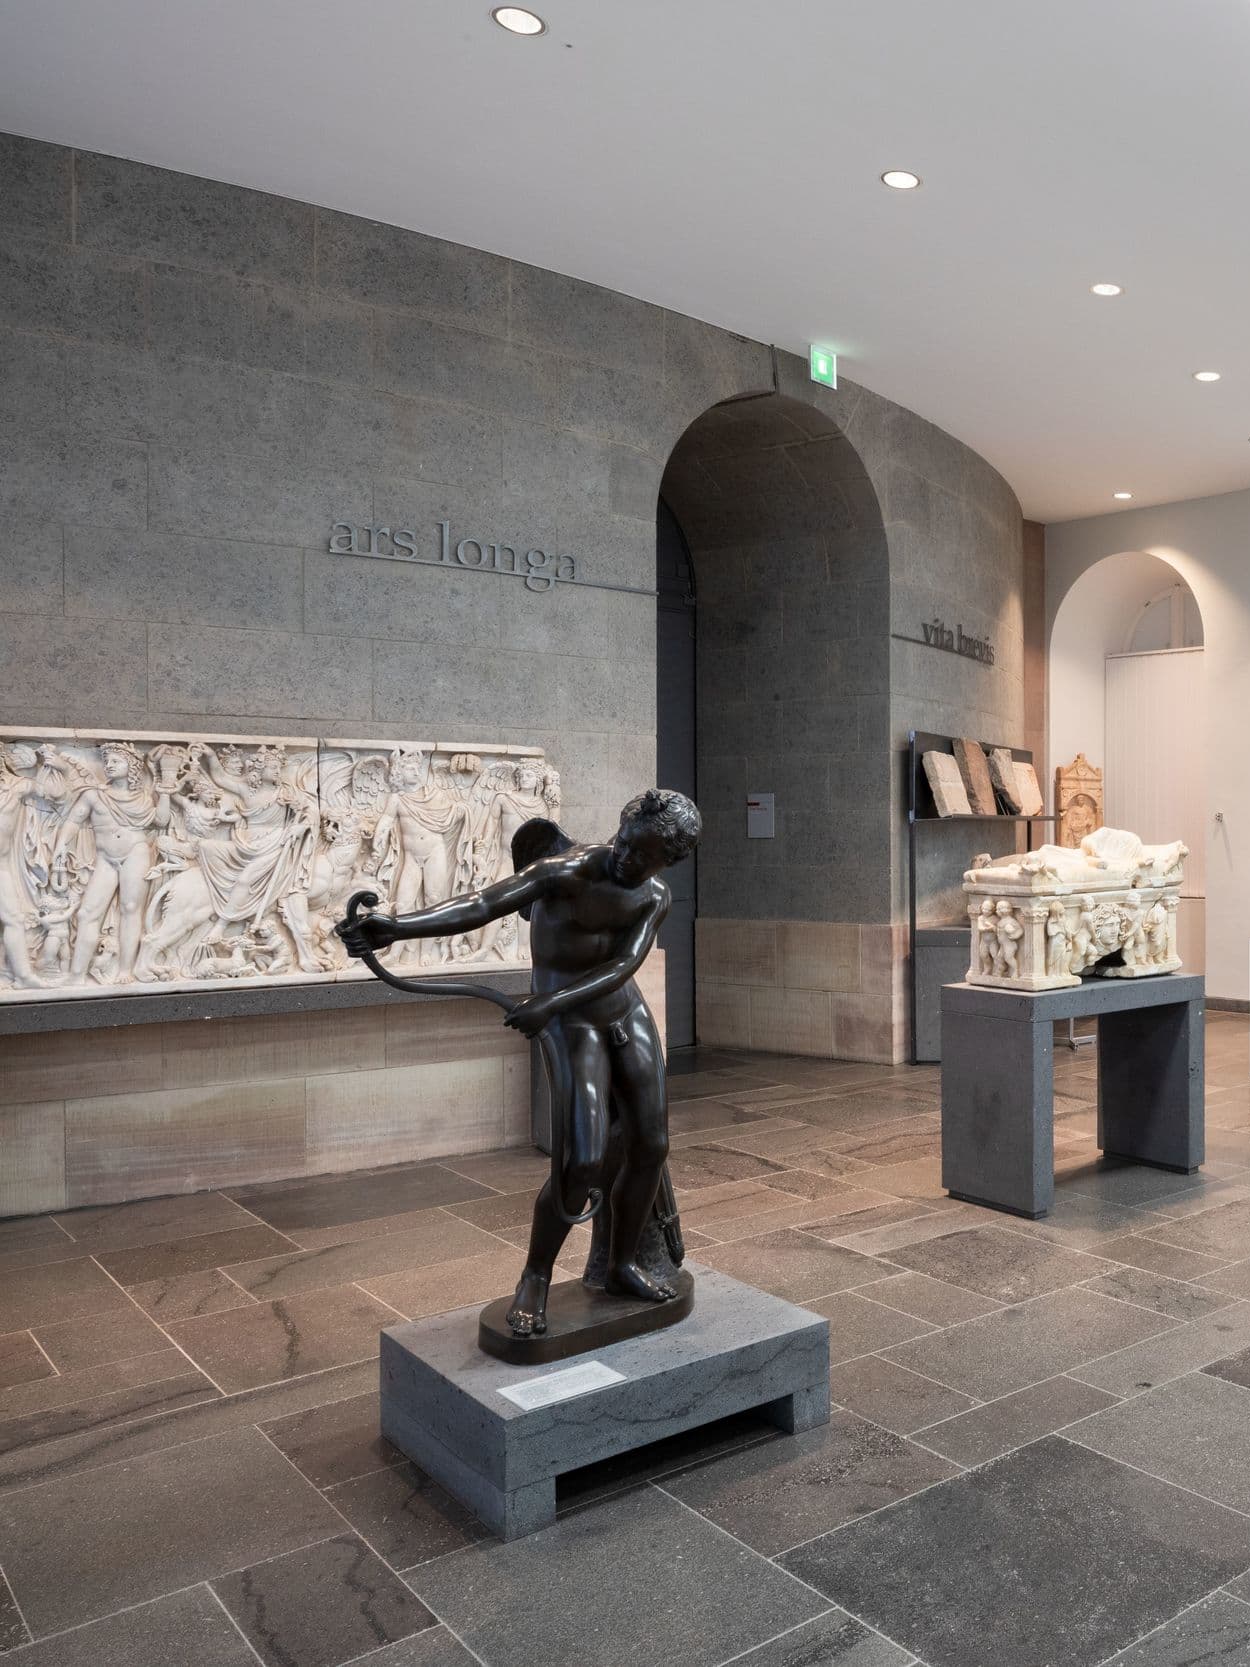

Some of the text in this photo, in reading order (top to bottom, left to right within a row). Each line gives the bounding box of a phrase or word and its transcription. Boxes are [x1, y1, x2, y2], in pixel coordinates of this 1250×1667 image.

[330, 519, 584, 592] ars longa
[921, 617, 954, 651] vita
